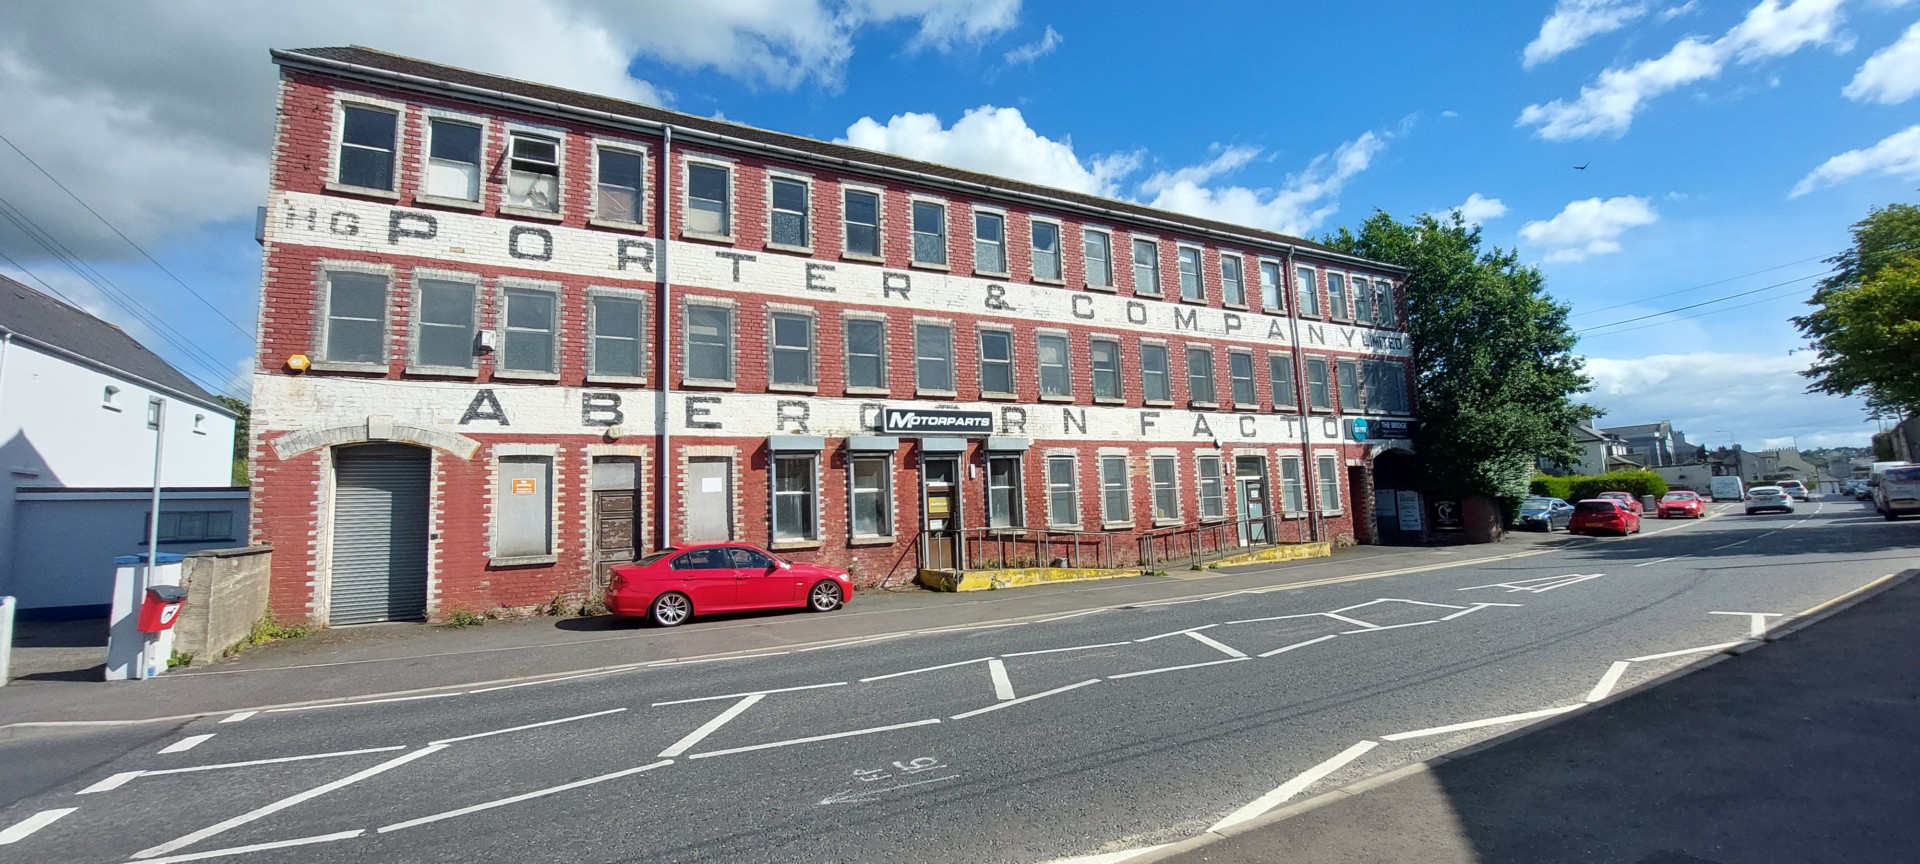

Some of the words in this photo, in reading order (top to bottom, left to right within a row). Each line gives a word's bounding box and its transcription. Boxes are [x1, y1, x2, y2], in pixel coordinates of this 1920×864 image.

[285, 204, 360, 236] HG
[388, 210, 912, 302] PORTER
[985, 284, 1017, 311] &
[1071, 293, 1355, 348] COMPANY
[1361, 329, 1403, 350] LIMITED
[458, 388, 1087, 435] ABERCRN
